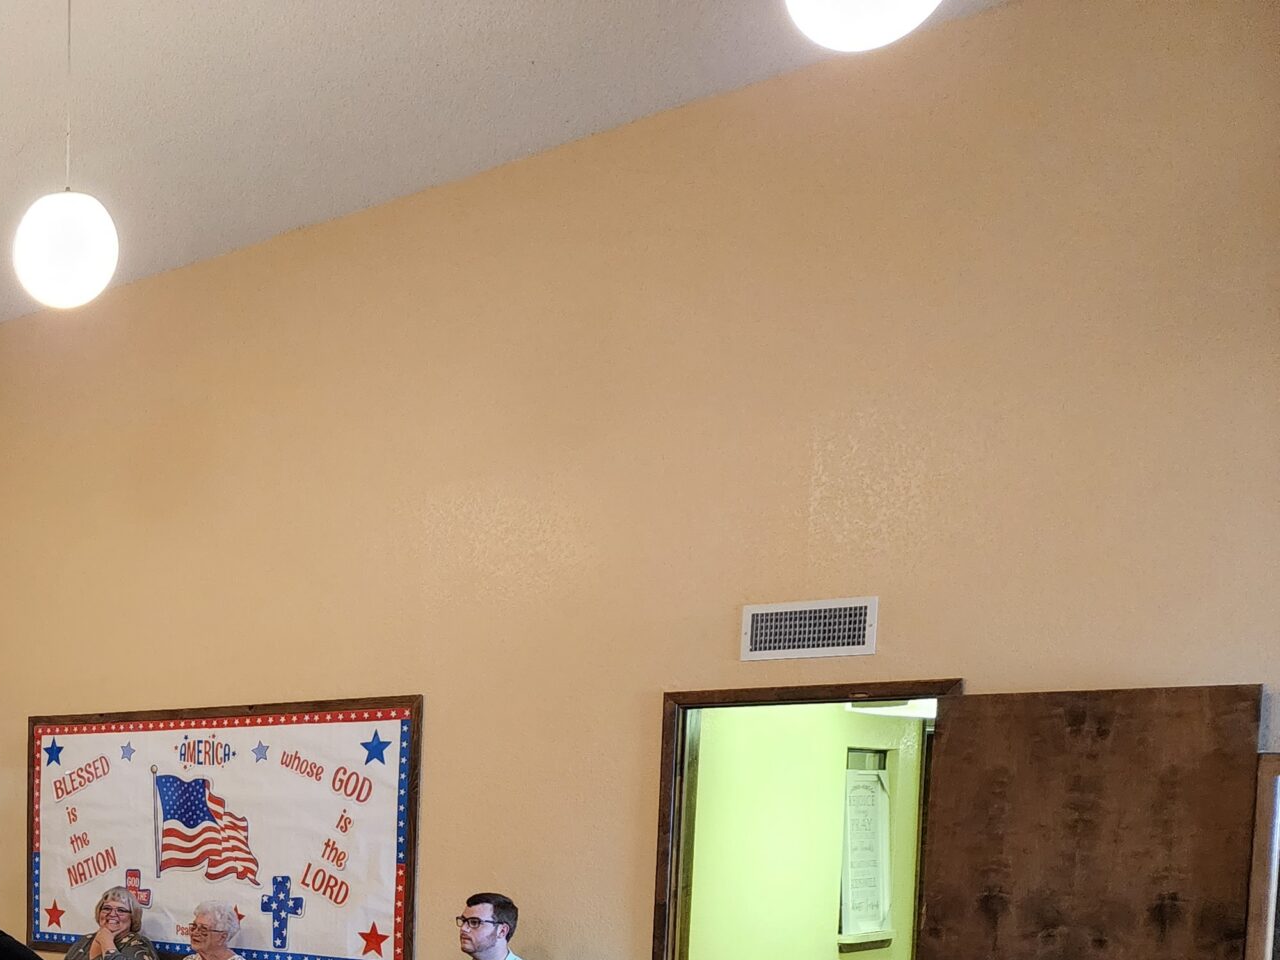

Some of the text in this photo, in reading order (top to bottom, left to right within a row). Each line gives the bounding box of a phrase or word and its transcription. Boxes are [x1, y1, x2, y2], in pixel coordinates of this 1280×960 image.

[179, 739, 231, 766] AMERICA
[53, 755, 111, 800] BLESSED
[280, 751, 373, 803] whose GOD
[65, 806, 79, 825] is
[335, 809, 352, 833] is
[70, 831, 90, 853] the
[321, 838, 347, 868] the
[67, 846, 118, 887] NATION
[300, 862, 350, 905] LORD
